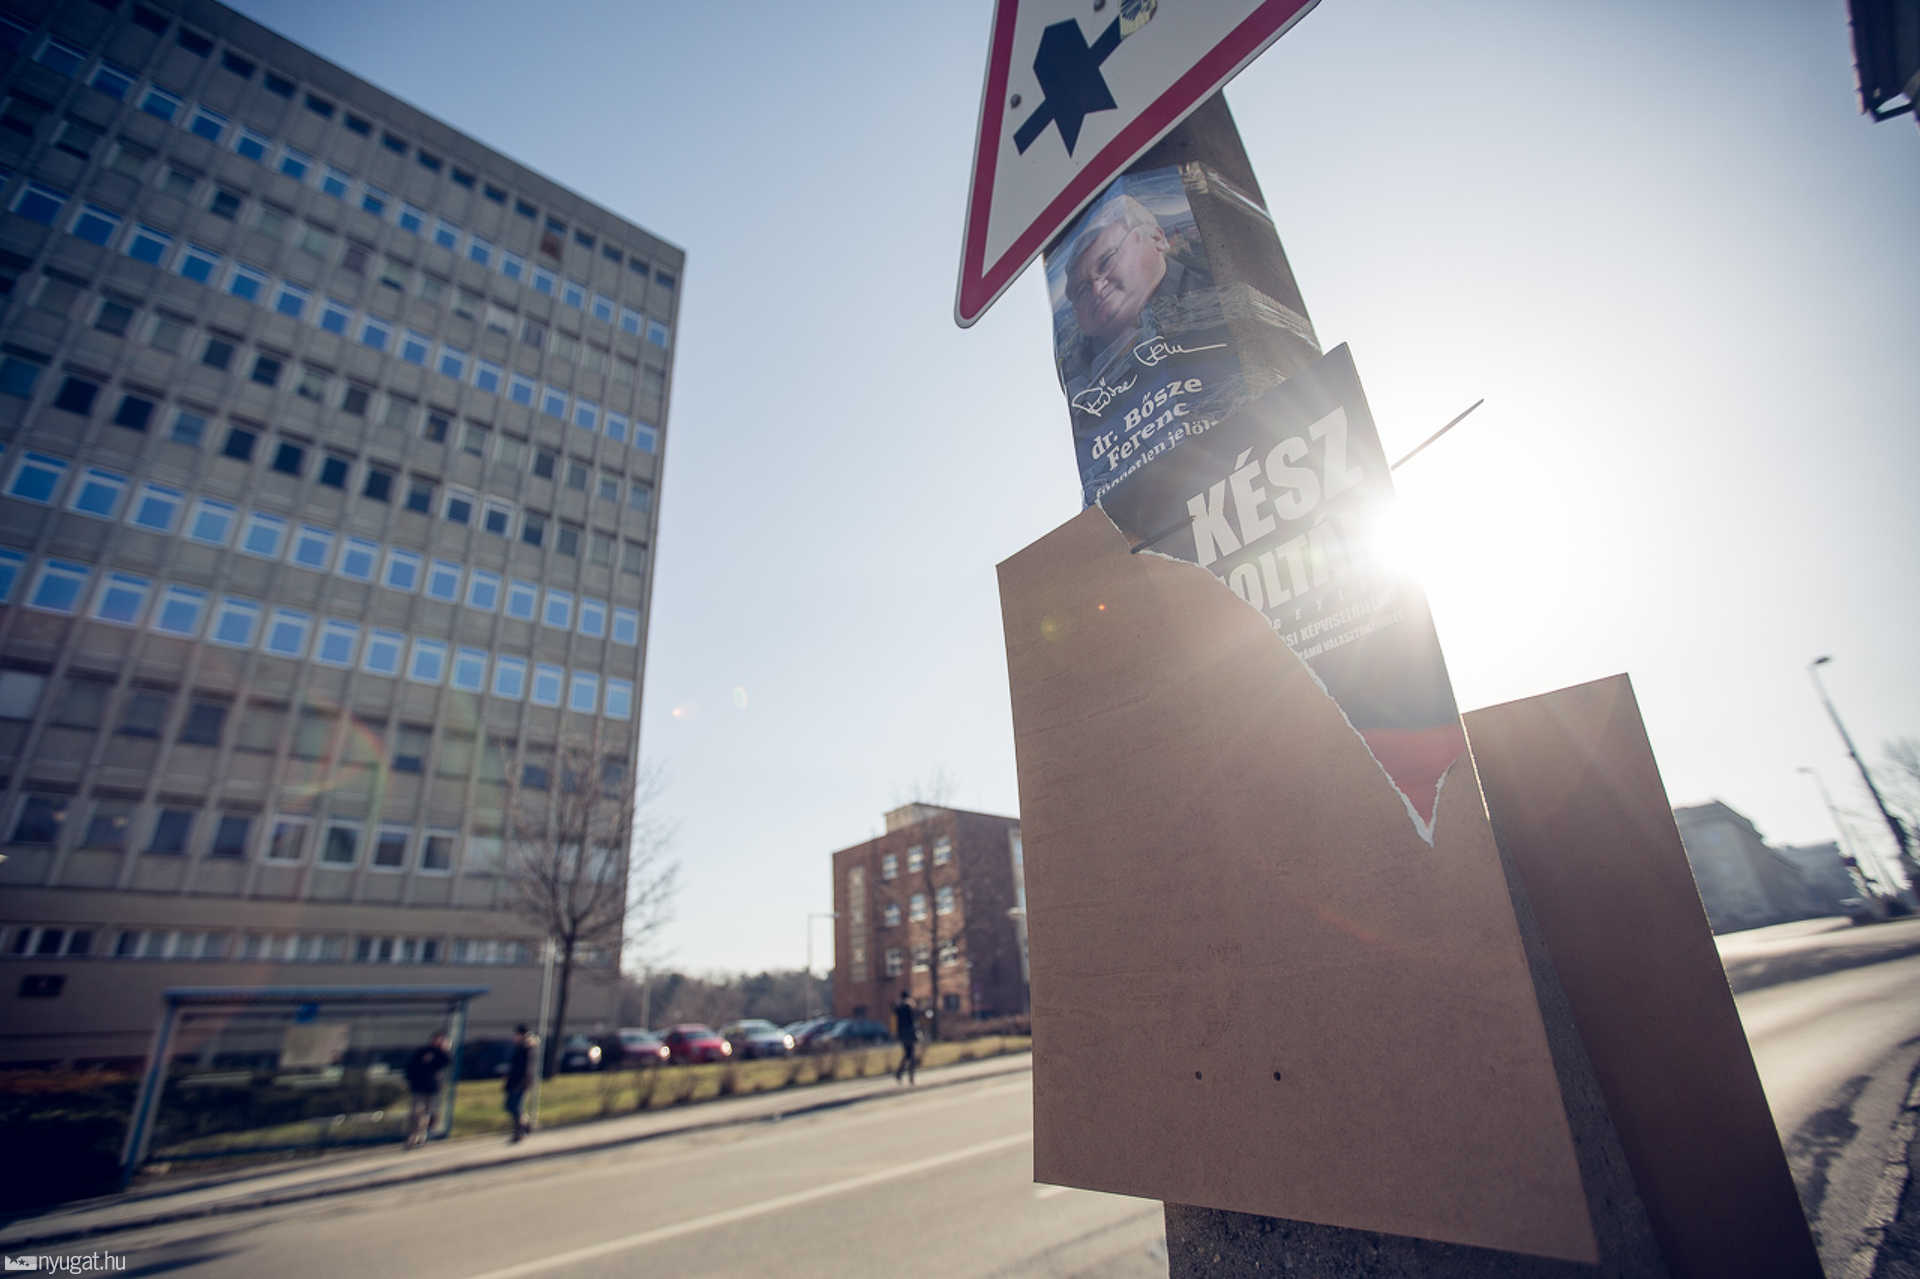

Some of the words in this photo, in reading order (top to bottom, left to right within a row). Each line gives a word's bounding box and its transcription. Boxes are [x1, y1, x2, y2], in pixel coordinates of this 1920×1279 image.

[1091, 430, 1118, 460] dr.
[1123, 377, 1203, 432] Bősze
[1107, 402, 1191, 471] Ferenc
[1167, 418, 1220, 450] jelöl
[1186, 405, 1364, 567] KÉSZ
